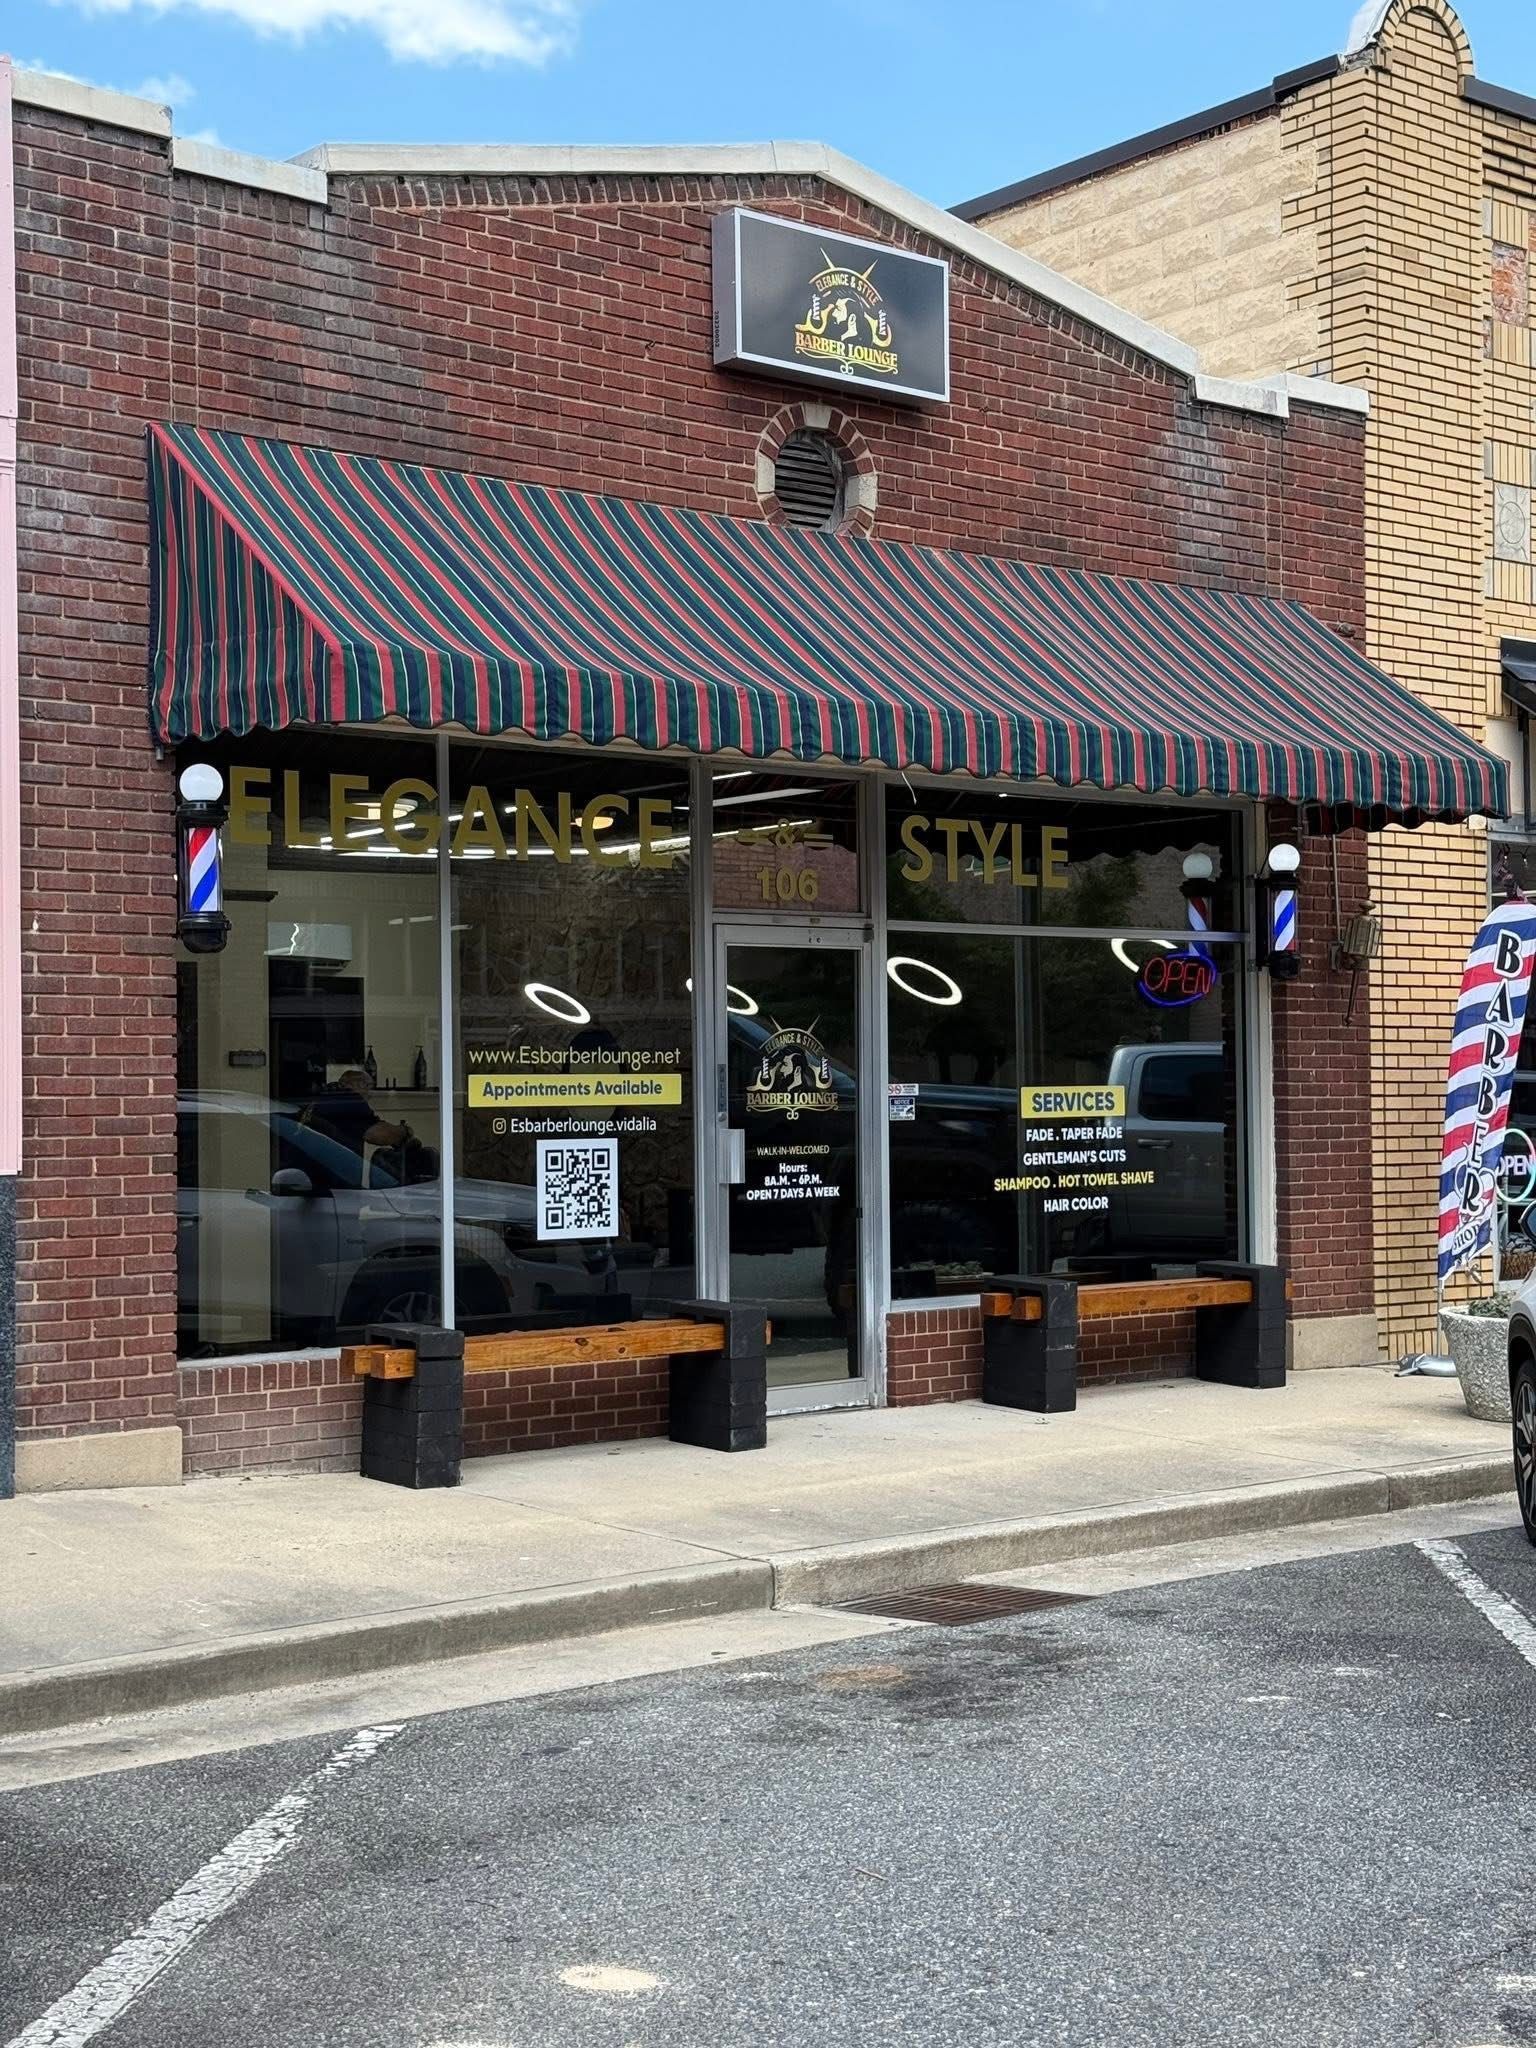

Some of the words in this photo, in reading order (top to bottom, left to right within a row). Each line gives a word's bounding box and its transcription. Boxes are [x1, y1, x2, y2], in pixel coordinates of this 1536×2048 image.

[850, 273, 857, 289] &
[857, 280, 880, 306] STYLE
[795, 331, 846, 357] BARBER
[847, 343, 898, 368] LOUNGE
[229, 765, 673, 869] ELEGANCE
[775, 818, 796, 849] &
[900, 814, 1069, 889] STYLE
[756, 866, 818, 902] 106
[1143, 956, 1213, 995] OPEN
[802, 1035, 821, 1056] STYLE
[468, 1045, 681, 1071] www.Esbarberlounge.net
[1459, 932, 1522, 1213] BARBER
[482, 1081, 591, 1100] Appointments
[594, 1079, 663, 1096] Available
[746, 1092, 792, 1105] BARBER
[793, 1092, 838, 1105] LOUNGE
[1031, 1091, 1115, 1113] SERVICES
[510, 1116, 657, 1135] Esbarberlounge.vidalia
[1026, 1128, 1054, 1142] FADE
[1061, 1126, 1094, 1140] TAPER
[1095, 1126, 1123, 1139] FADE
[756, 1144, 830, 1156] WALK-IN-WELCOMED
[1023, 1151, 1097, 1166] GENTLEMAN'S
[1099, 1149, 1127, 1163] CUTS
[778, 1162, 808, 1173] Hours:
[764, 1174, 791, 1187] 8A.M.
[798, 1173, 823, 1185] 6P.M.
[993, 1176, 1051, 1191] SHAMPOO
[1058, 1174, 1081, 1188] HOT
[1082, 1172, 1119, 1187] TOWEL
[1120, 1170, 1155, 1185] SHAVE
[746, 1188, 772, 1201] OPEN
[773, 1188, 779, 1199] 7
[780, 1187, 804, 1199] DAYS
[805, 1187, 813, 1198] A
[813, 1185, 840, 1197] WEEK
[1043, 1198, 1070, 1213] HAIR
[1071, 1196, 1109, 1211] COLOR
